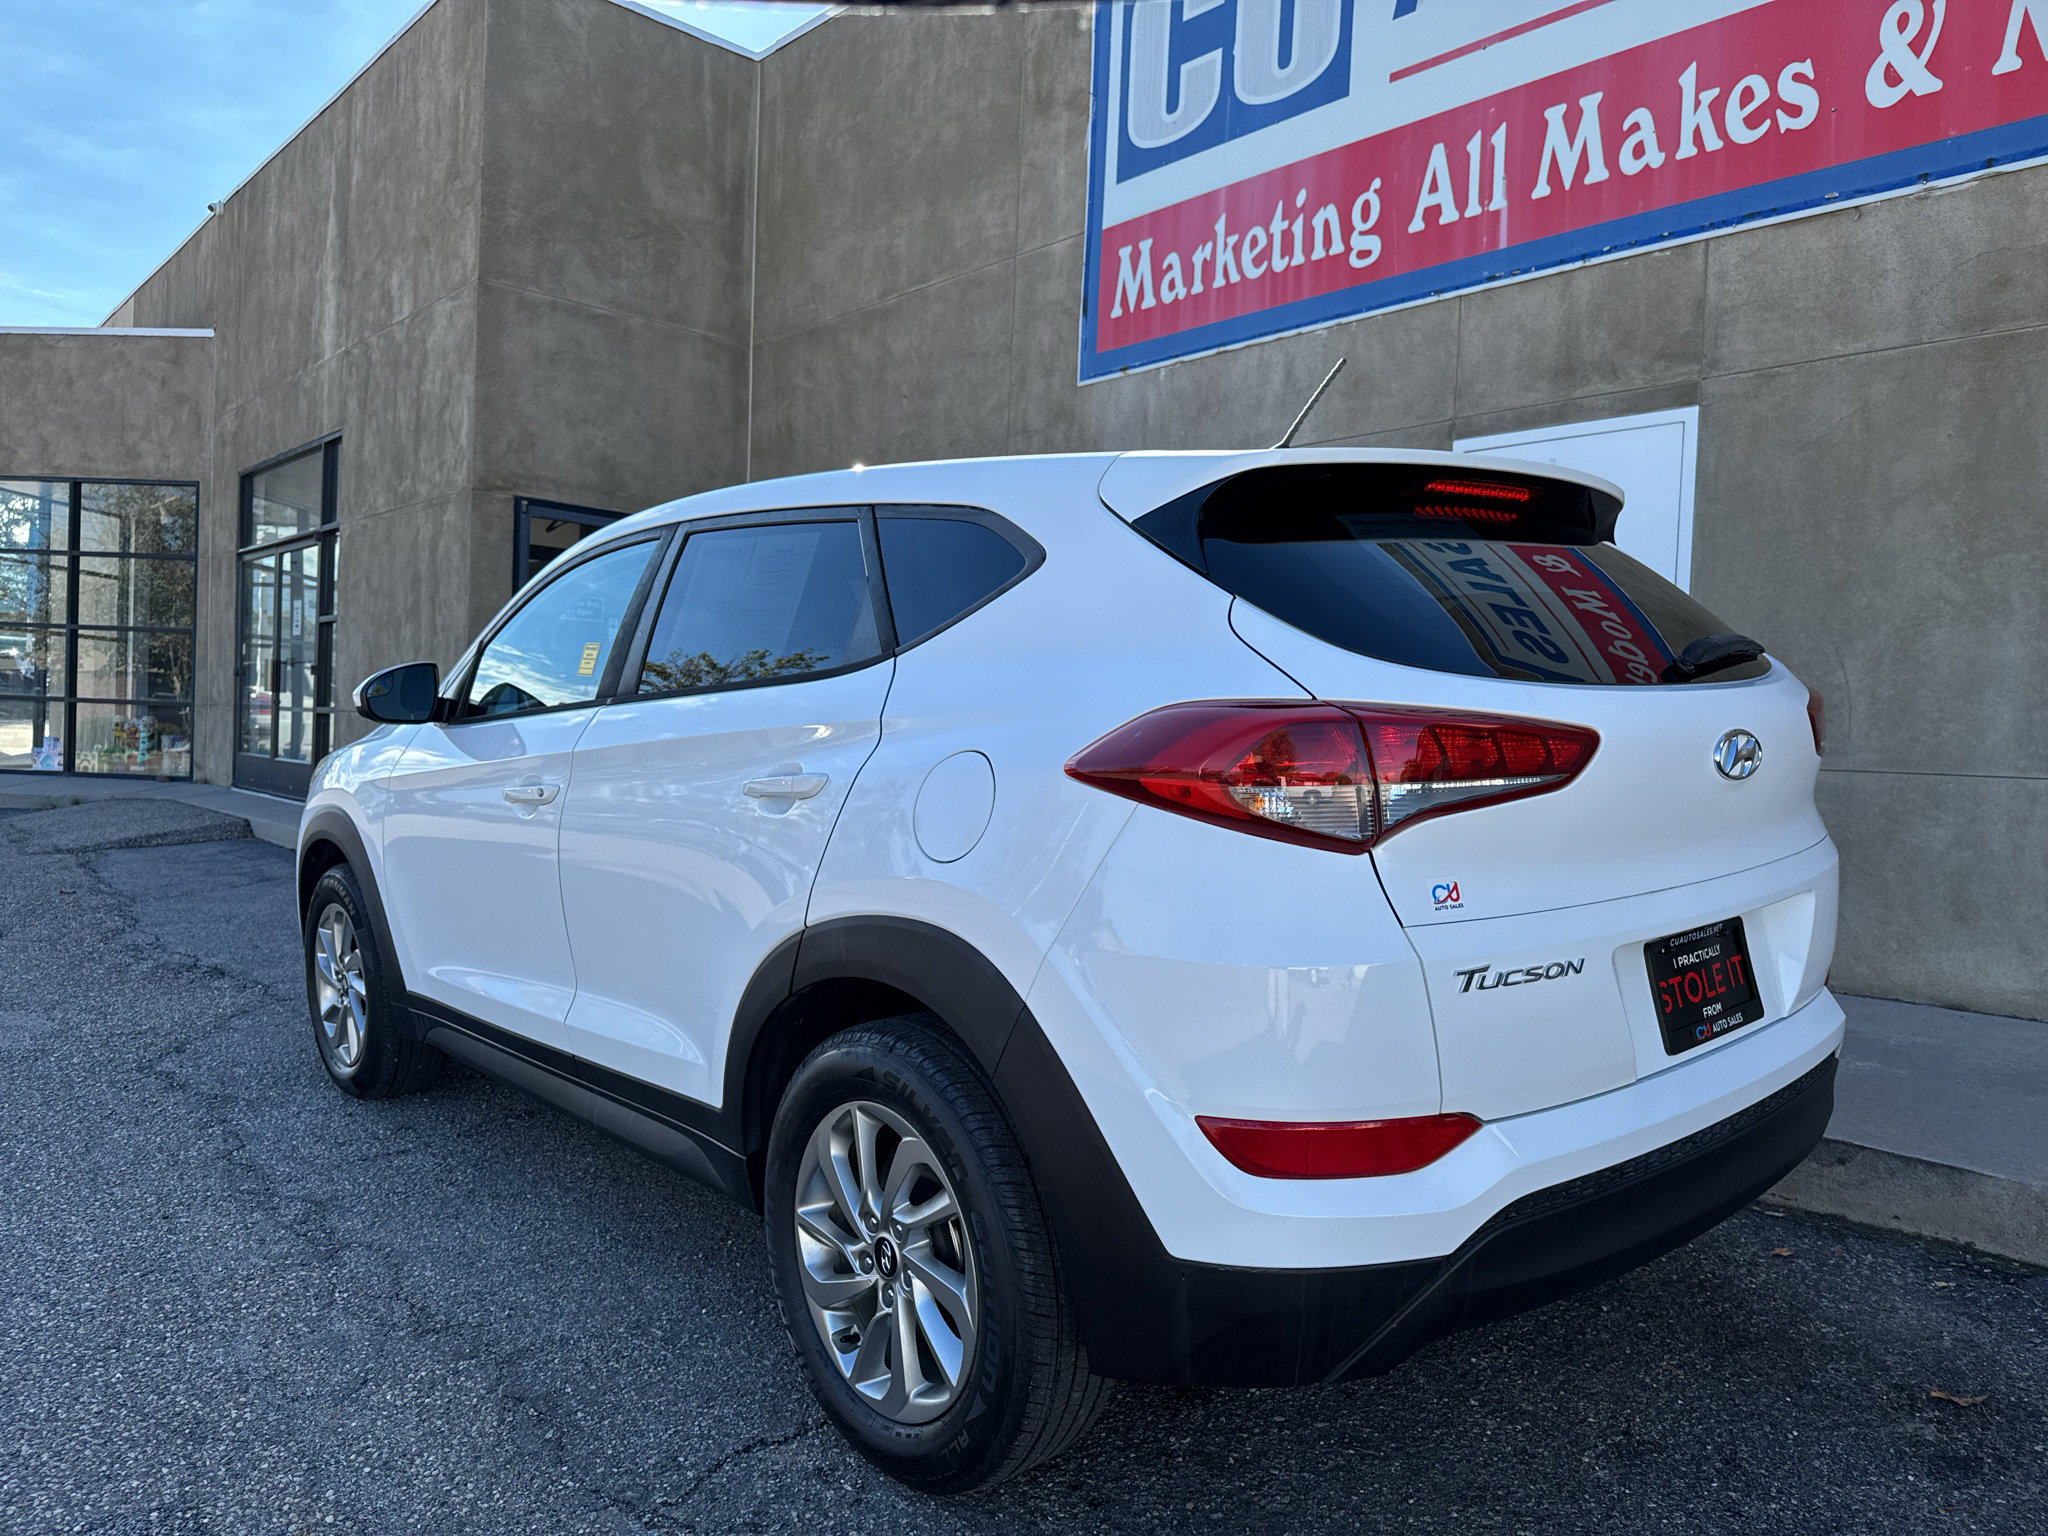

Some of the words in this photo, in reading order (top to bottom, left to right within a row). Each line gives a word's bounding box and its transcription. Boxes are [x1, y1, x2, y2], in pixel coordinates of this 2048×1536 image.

[1127, 0, 1341, 148] CU
[1110, 178, 1381, 319] Marketing
[1407, 122, 1508, 234] All
[1531, 59, 1820, 200] Makes
[1864, 0, 1947, 109] &
[1673, 958, 1677, 969] I
[1677, 943, 1721, 968] PRACTICALLY
[1659, 962, 1727, 1014] STOLE
[1725, 954, 1744, 988] IT
[1702, 1001, 1723, 1019] FROM
[1712, 1018, 1728, 1033] AUTO
[1727, 1012, 1744, 1027] SALES
